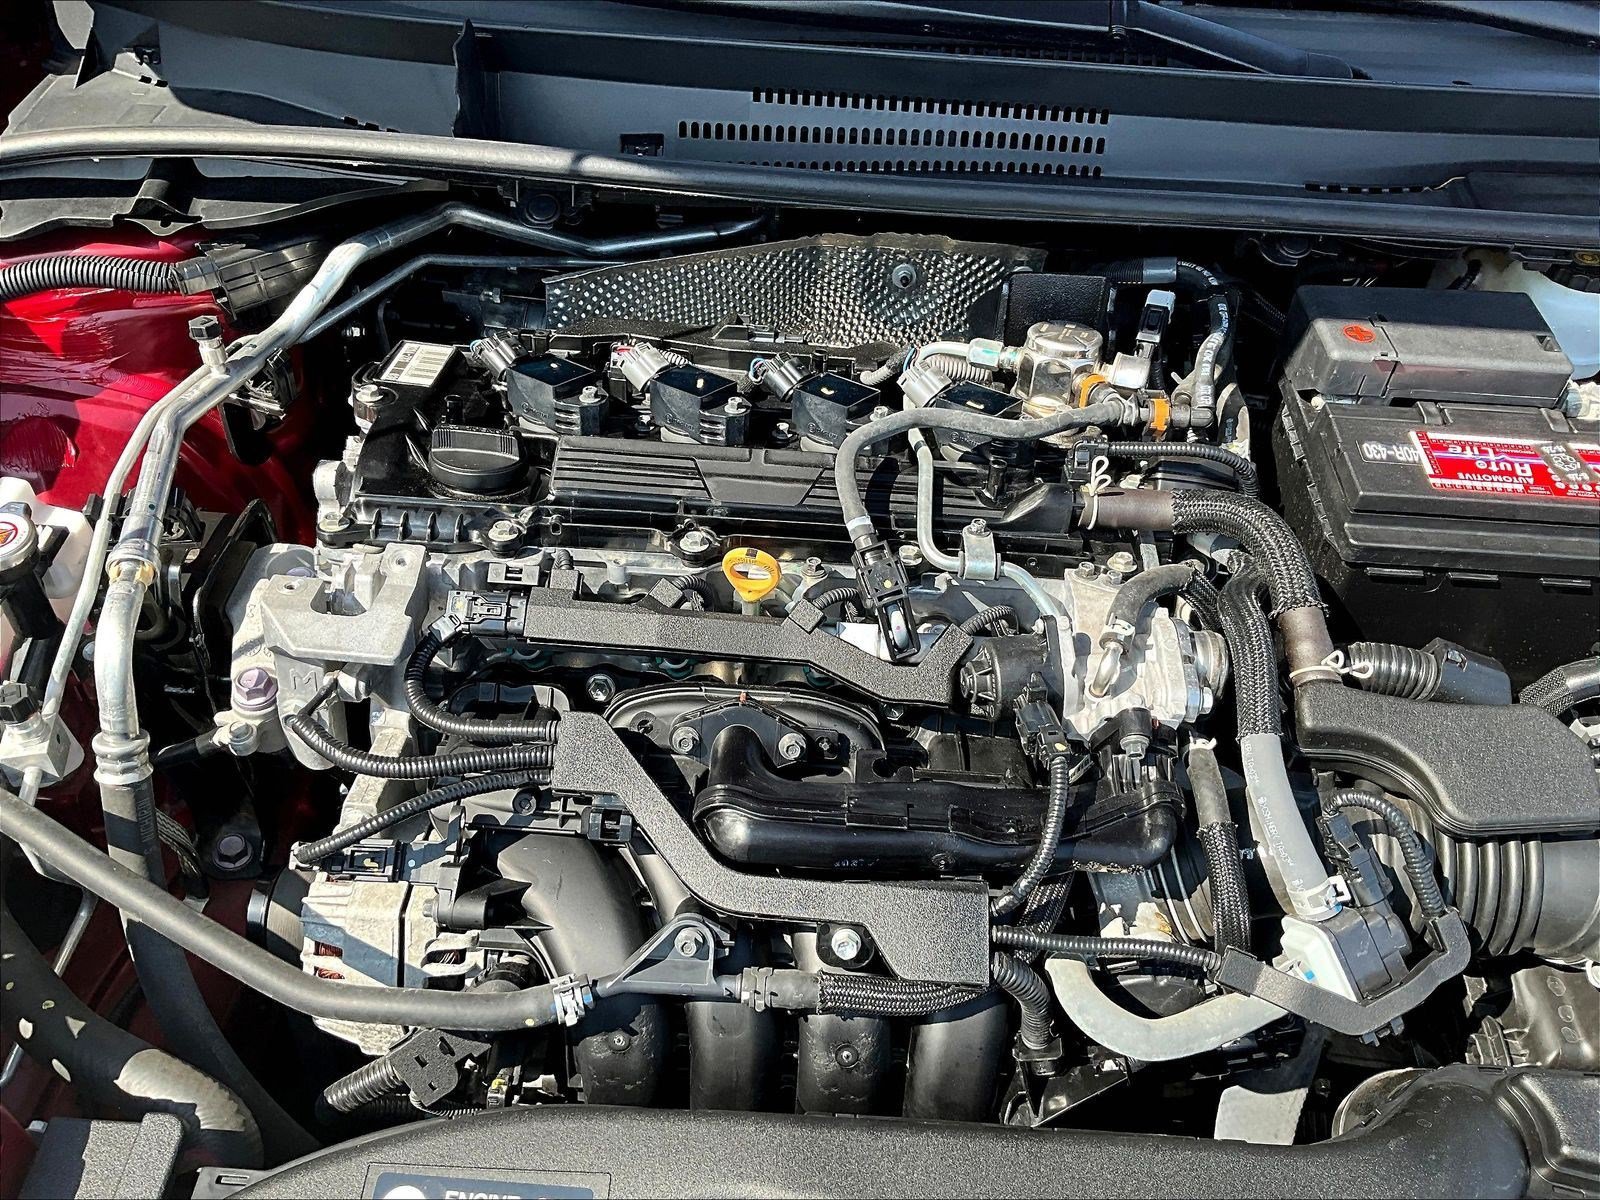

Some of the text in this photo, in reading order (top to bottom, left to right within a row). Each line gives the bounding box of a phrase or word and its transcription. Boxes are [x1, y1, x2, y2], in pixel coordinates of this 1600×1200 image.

[1446, 444, 1494, 460] Life
[1475, 460, 1532, 477] Auto
[1457, 472, 1534, 485] AUTOMOTIVE
